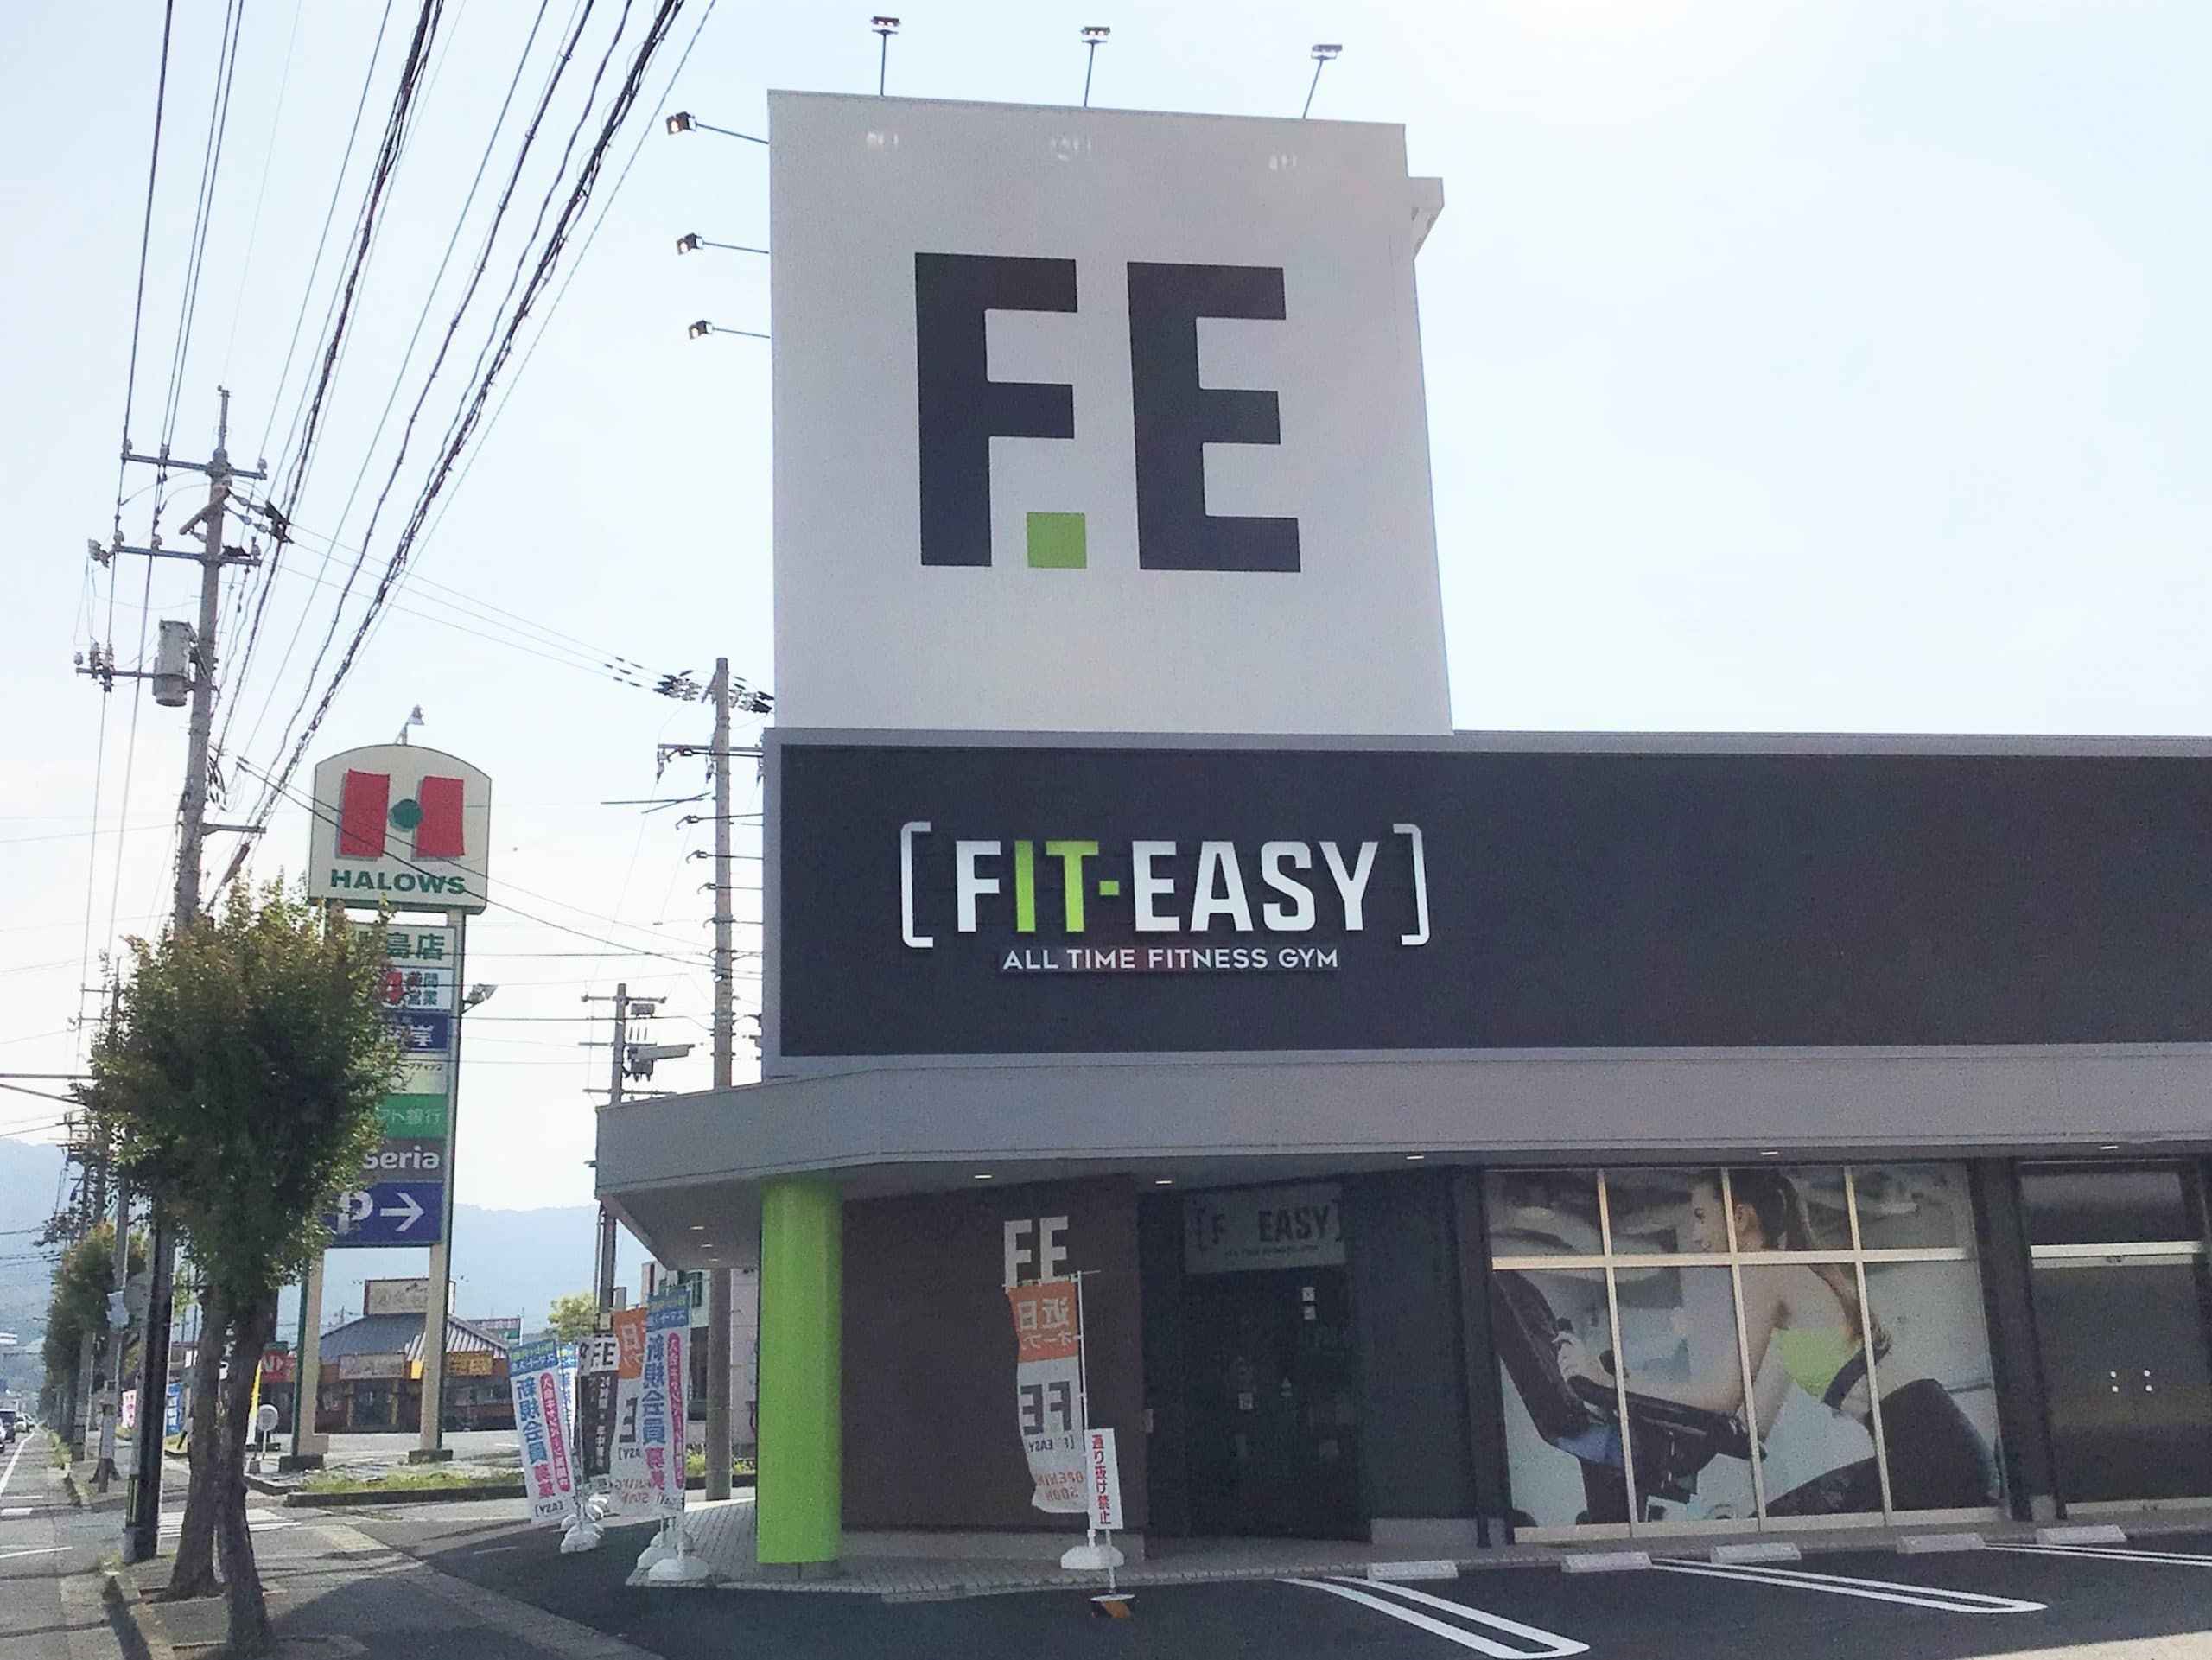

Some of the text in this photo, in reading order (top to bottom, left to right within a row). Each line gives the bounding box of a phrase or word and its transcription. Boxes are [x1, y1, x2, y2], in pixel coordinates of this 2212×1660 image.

[330, 868, 466, 895] HALOWS
[1002, 948, 1338, 970] ALL TIME FITNESS GYM
[374, 1108, 442, 1127] マト銀行
[337, 1191, 373, 1236] P
[1091, 1434, 1112, 1525] 通り抜け禁止
